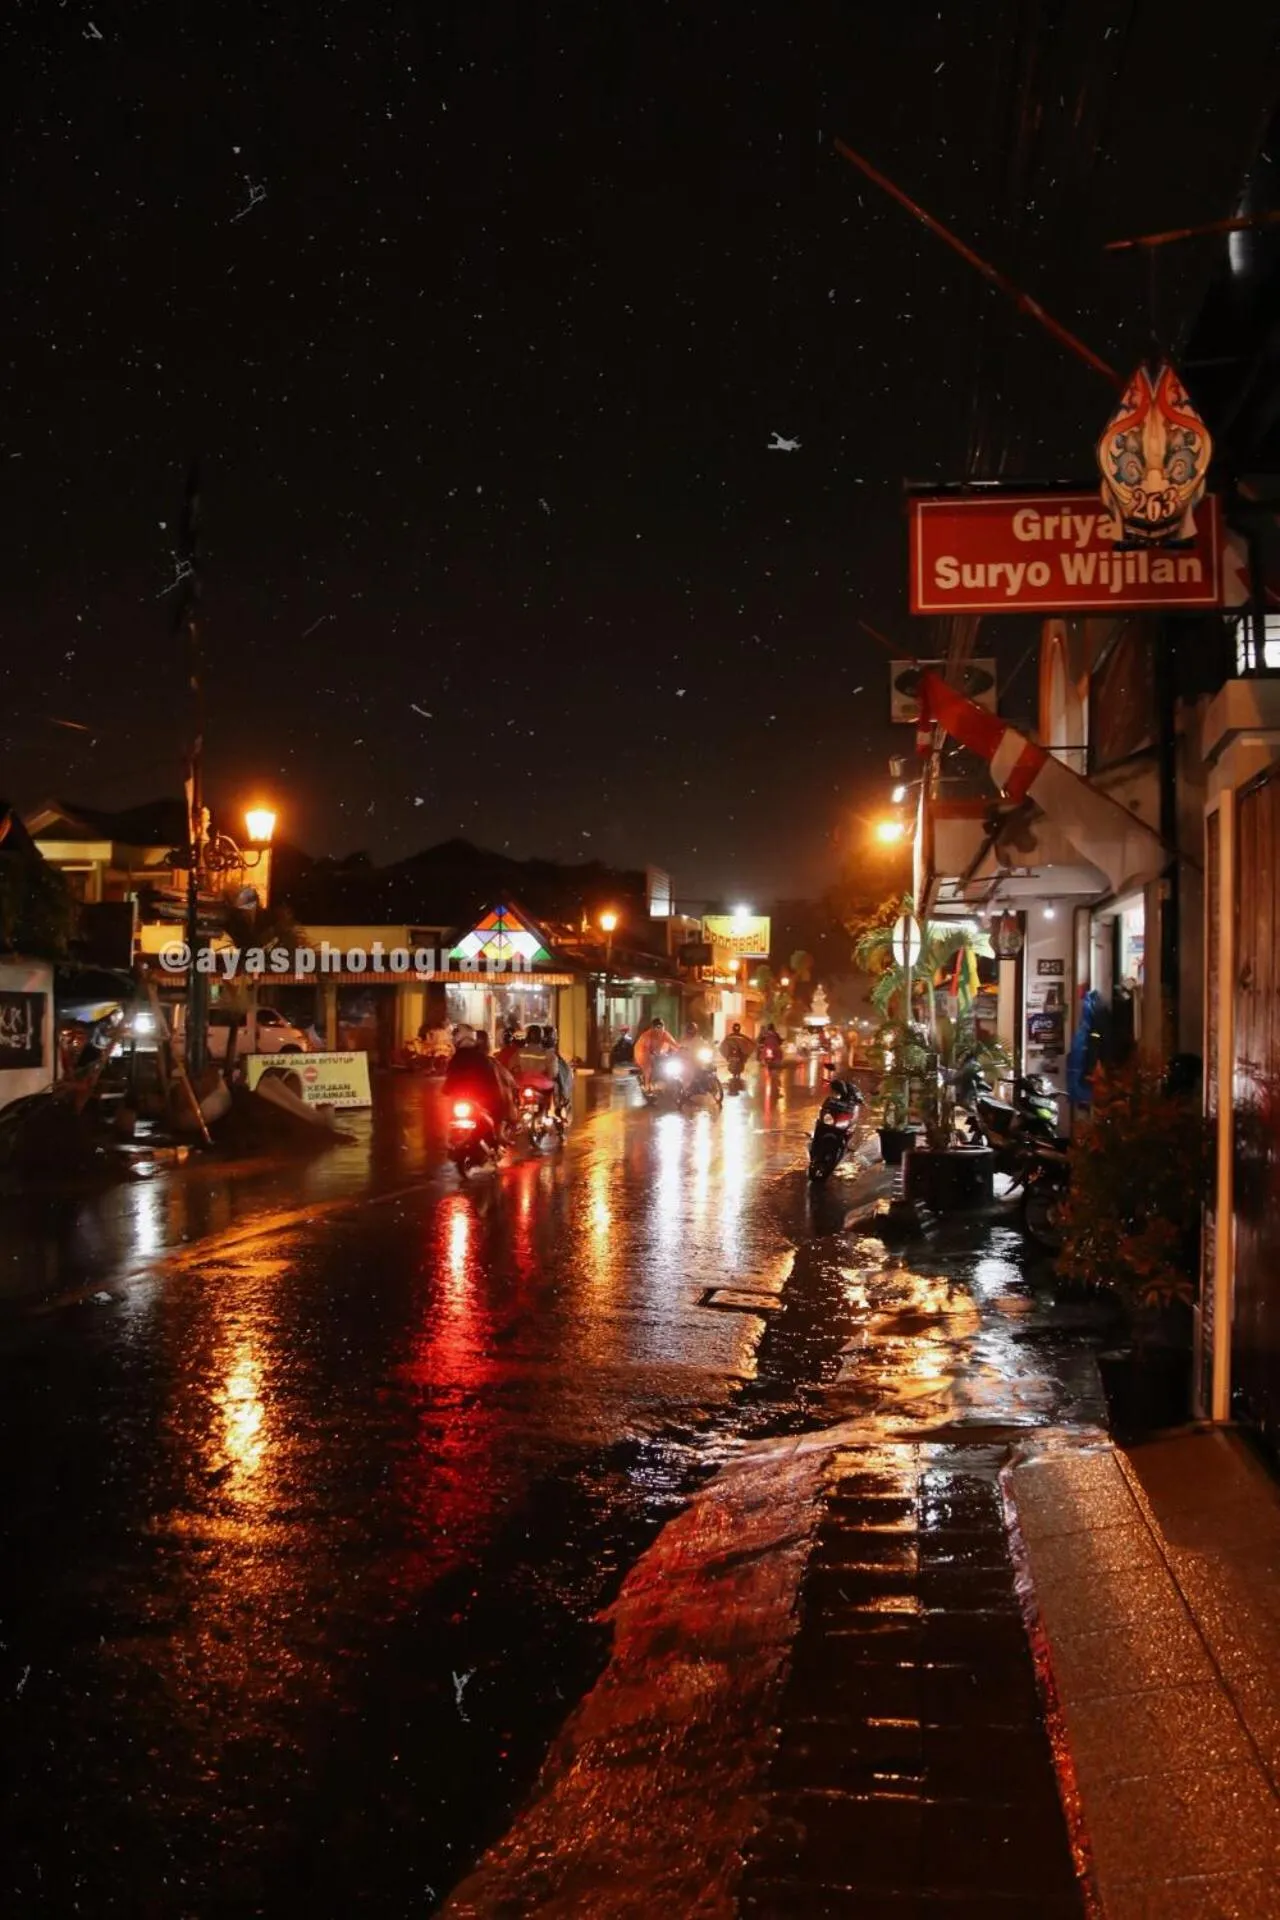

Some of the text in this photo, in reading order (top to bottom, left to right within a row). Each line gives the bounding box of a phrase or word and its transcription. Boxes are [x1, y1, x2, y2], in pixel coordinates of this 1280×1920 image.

[1133, 487, 1179, 523] 263
[1012, 507, 1119, 544] Griya
[934, 552, 1202, 596] Suryo Wijilan
